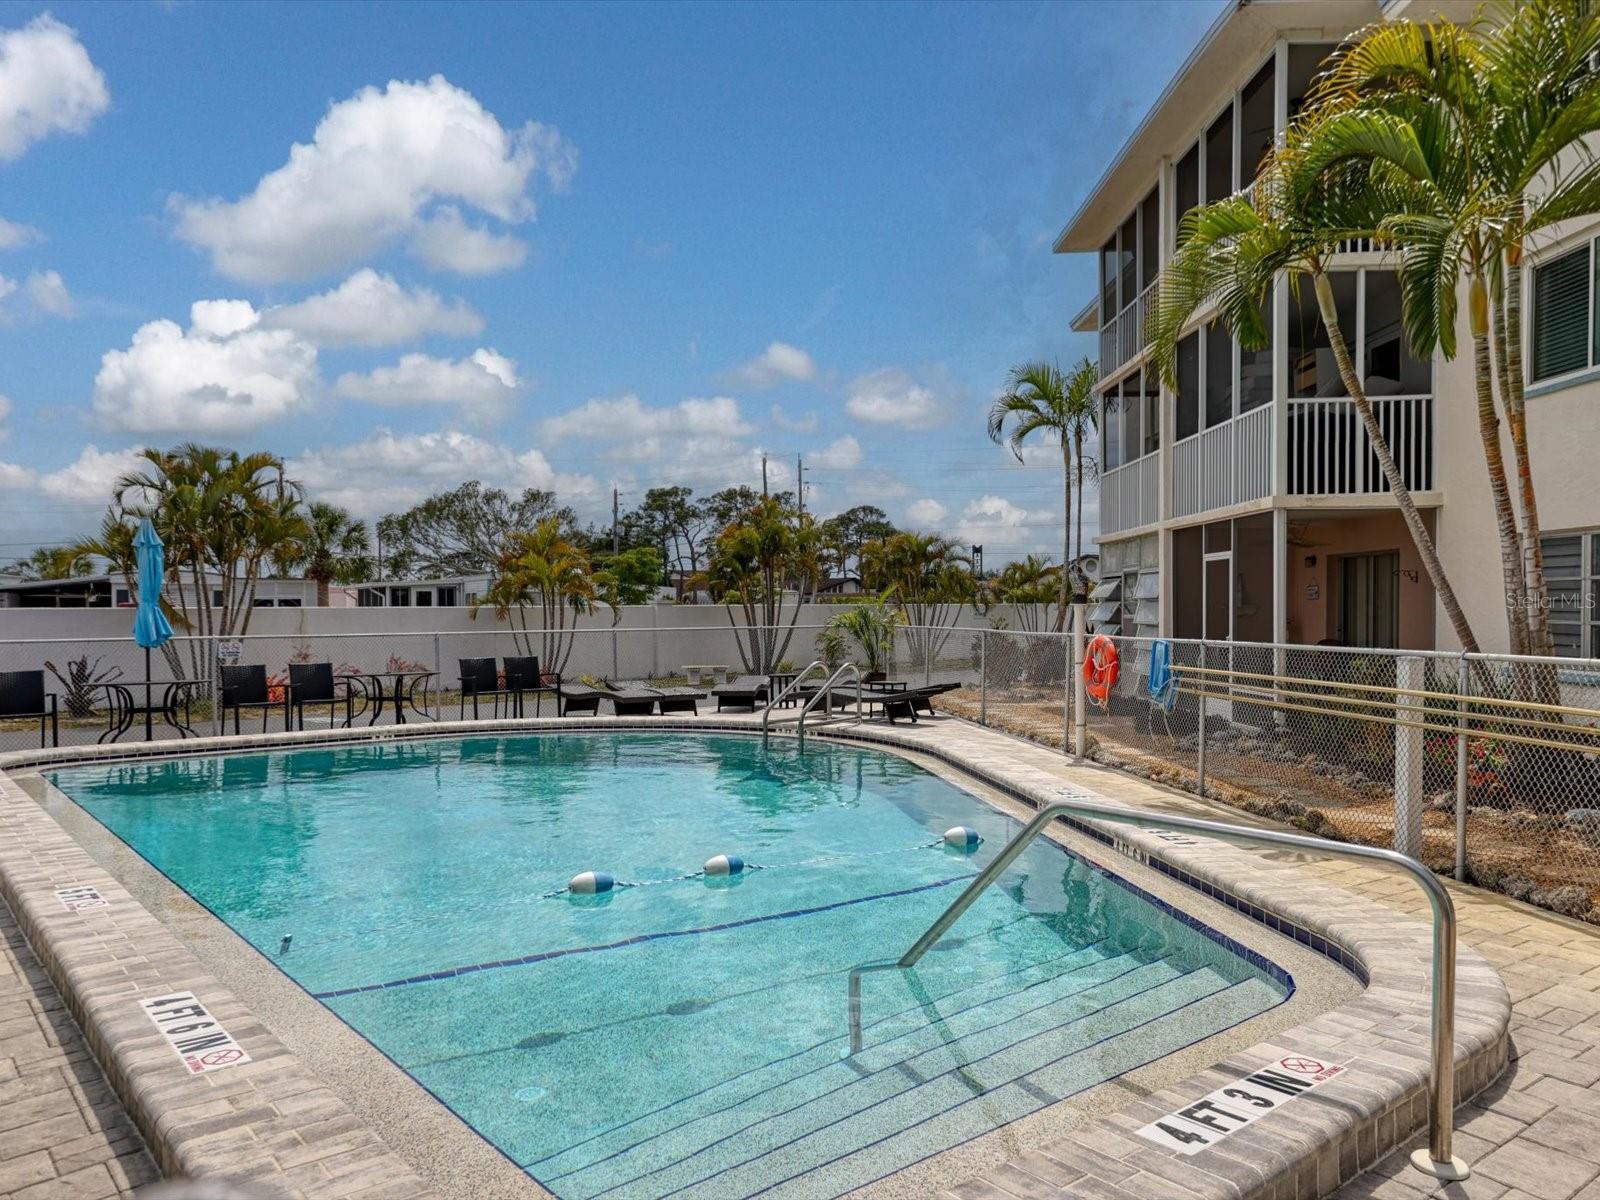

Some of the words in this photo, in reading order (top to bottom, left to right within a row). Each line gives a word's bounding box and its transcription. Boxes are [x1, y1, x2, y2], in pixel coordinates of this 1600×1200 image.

[145, 996, 193, 1008] 4
[152, 1004, 207, 1022] FT
[166, 1021, 215, 1035] 6
[173, 1032, 232, 1054] IN
[1244, 1069, 1314, 1096] IN
[1223, 1088, 1275, 1108] 3
[1177, 1100, 1249, 1132] FT
[1155, 1122, 1209, 1145] 4
